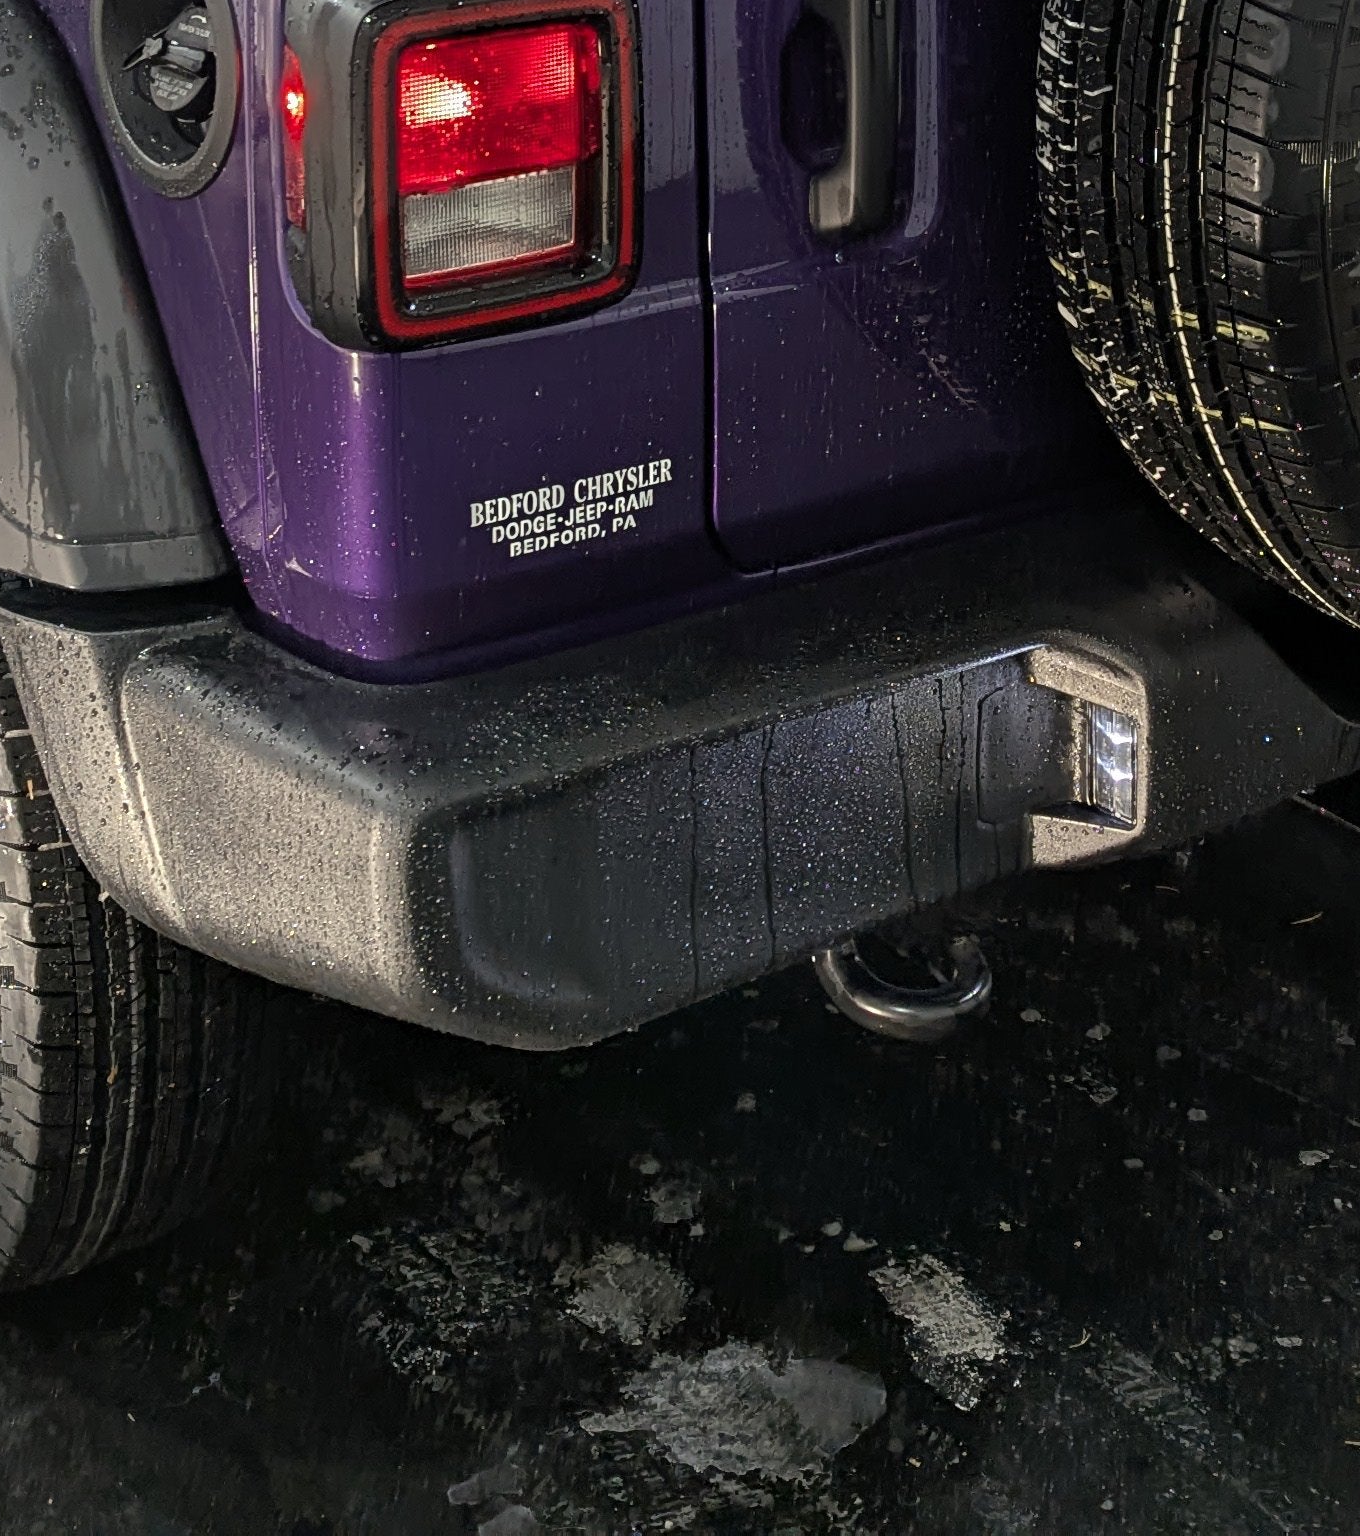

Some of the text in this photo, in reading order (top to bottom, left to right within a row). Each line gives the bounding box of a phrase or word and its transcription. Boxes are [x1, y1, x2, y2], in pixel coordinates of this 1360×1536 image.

[469, 458, 673, 528] BEDFORD CHRYSLER
[509, 514, 637, 558] BEDFORD, PA
